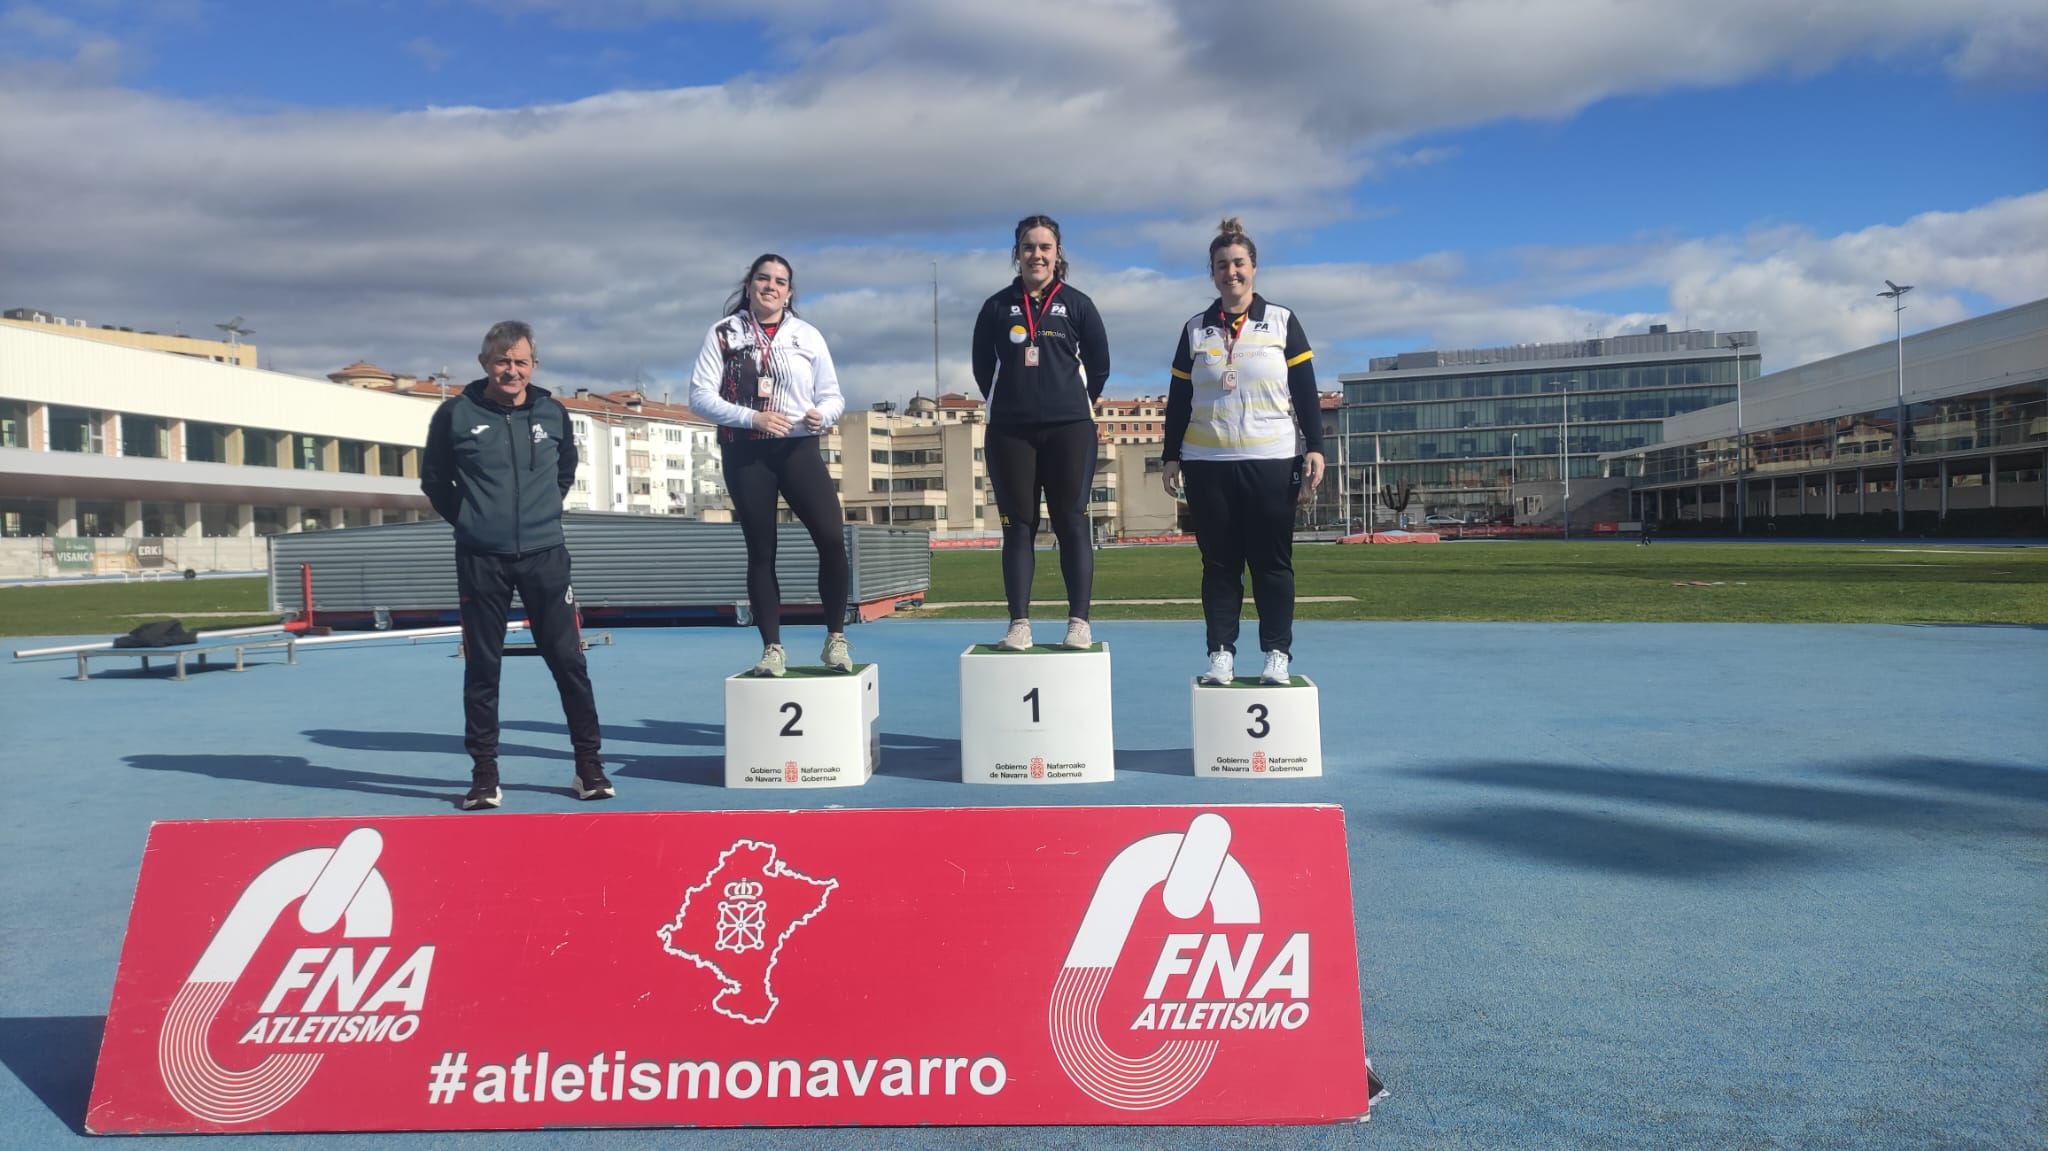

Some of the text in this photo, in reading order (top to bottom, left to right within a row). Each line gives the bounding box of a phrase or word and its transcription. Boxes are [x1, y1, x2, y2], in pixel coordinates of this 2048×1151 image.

[1051, 305, 1066, 314] PA
[1023, 687, 1040, 723] 1
[779, 701, 803, 737] 2
[1246, 703, 1271, 739] 3
[1046, 762, 1086, 770] Nafarroako
[1216, 756, 1250, 764] Gobierno
[1222, 765, 1250, 773] Navarra
[1268, 756, 1308, 764] Nafarroako
[744, 775, 782, 783] de Navarra
[800, 766, 841, 774] Nafarroako
[989, 771, 1028, 779] de Navarra
[1143, 932, 1311, 1000] FNA
[257, 945, 436, 1014] FNA
[1129, 1001, 1311, 1030] ATLETISMO
[238, 1014, 421, 1044] ATLETISMO
[428, 1050, 1007, 1104] #atletismonavarro
